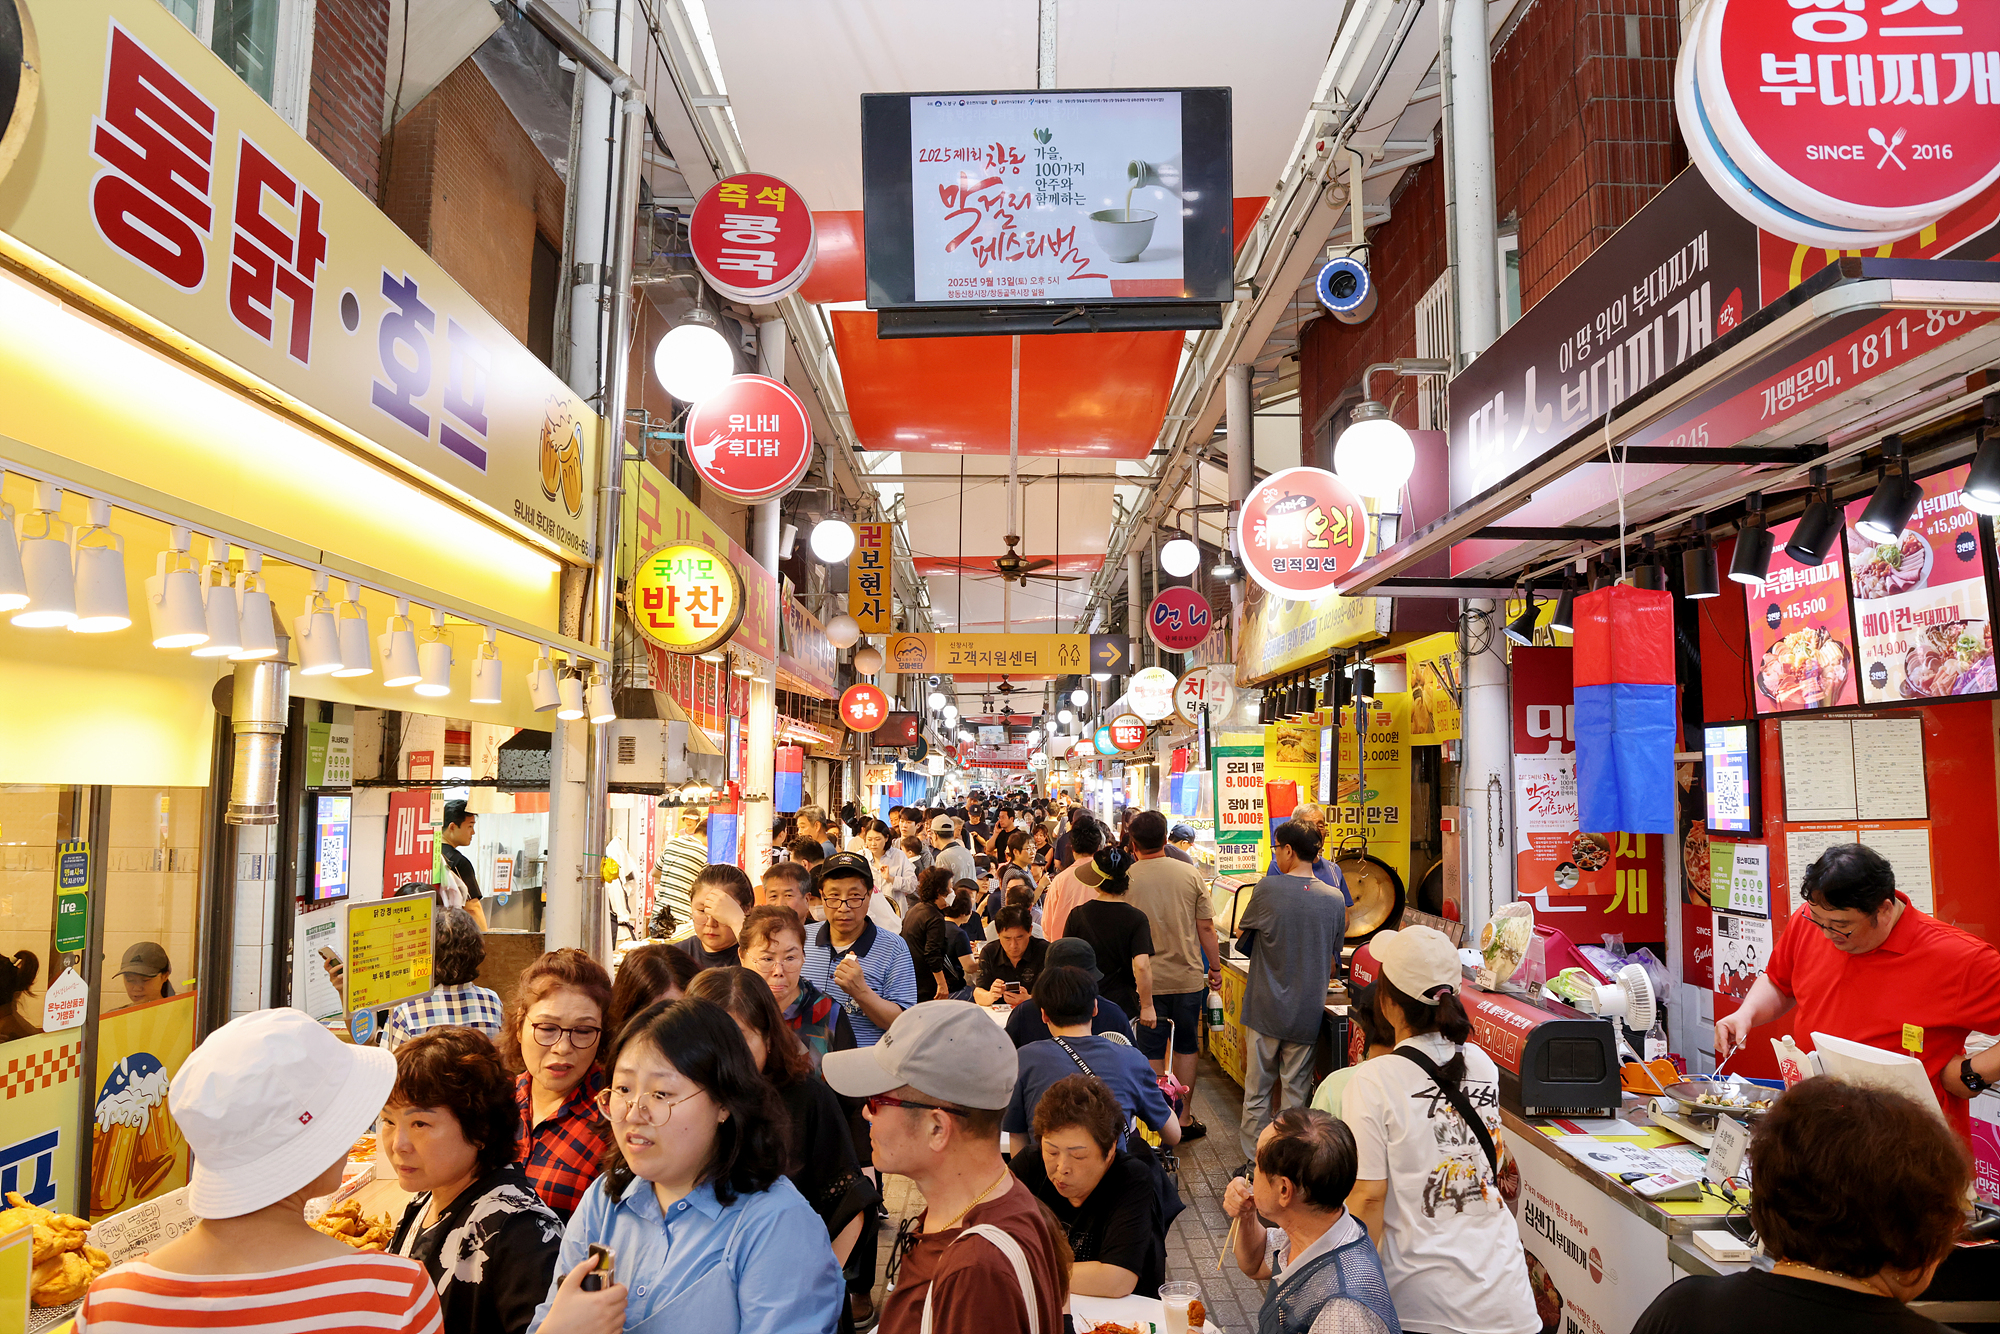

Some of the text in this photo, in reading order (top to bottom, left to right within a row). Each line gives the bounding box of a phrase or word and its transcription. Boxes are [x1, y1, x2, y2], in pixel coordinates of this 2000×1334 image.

[1760, 51, 2000, 107] 부대찌개
[919, 147, 951, 163] 2025
[985, 142, 1026, 175] 창동
[1034, 146, 1063, 161] 가을,
[1806, 144, 1953, 160] SINCE 2016
[1035, 162, 1085, 176] 100가지
[1035, 178, 1074, 191] 안주와
[718, 182, 786, 212] 즉석
[1035, 192, 1087, 206] 함께하는
[939, 171, 1032, 253] 막걸리
[717, 213, 781, 281] 콩국
[970, 225, 1109, 281] 페스티벌
[947, 275, 1060, 287] 2025년 9월 13일(토) 오후 5시
[1031, 287, 1045, 297] 일원
[1559, 229, 1708, 373] 이 땅 위의 부대찌개
[1761, 355, 1841, 420] 가맹문의.
[728, 414, 780, 432] 유나네
[728, 439, 780, 457] 후다닭
[1275, 495, 1308, 514] 가마솥
[514, 498, 535, 527] 유나네
[536, 510, 556, 538] 후다닭
[1305, 504, 1354, 549] 오리
[653, 558, 714, 582] 국사모
[1272, 558, 1336, 572] 원적외선
[857, 550, 886, 624] 보현사
[642, 585, 724, 629] 반찬
[1155, 603, 1207, 631] 언니
[950, 641, 974, 649] 신창시장
[898, 662, 923, 670] 모아센터
[947, 651, 1037, 667] 고객지원센터
[1184, 678, 1227, 702] 치킨
[850, 702, 878, 719] 정육
[1115, 727, 1142, 743] 반찬
[1227, 762, 1248, 773] 오리
[1228, 799, 1249, 810] 장어
[1526, 783, 1559, 812] 막걸리
[1367, 807, 1399, 824] 만원
[395, 807, 434, 856] 메뉴
[1218, 844, 1256, 855] 가마솥오리
[1737, 856, 1760, 866] 땅스부대찌개
[1696, 926, 1711, 936] SINCE
[47, 999, 84, 1013] 온누리상품권
[56, 1009, 75, 1021] 가맹점
[1974, 1157, 1999, 1182] 되는
